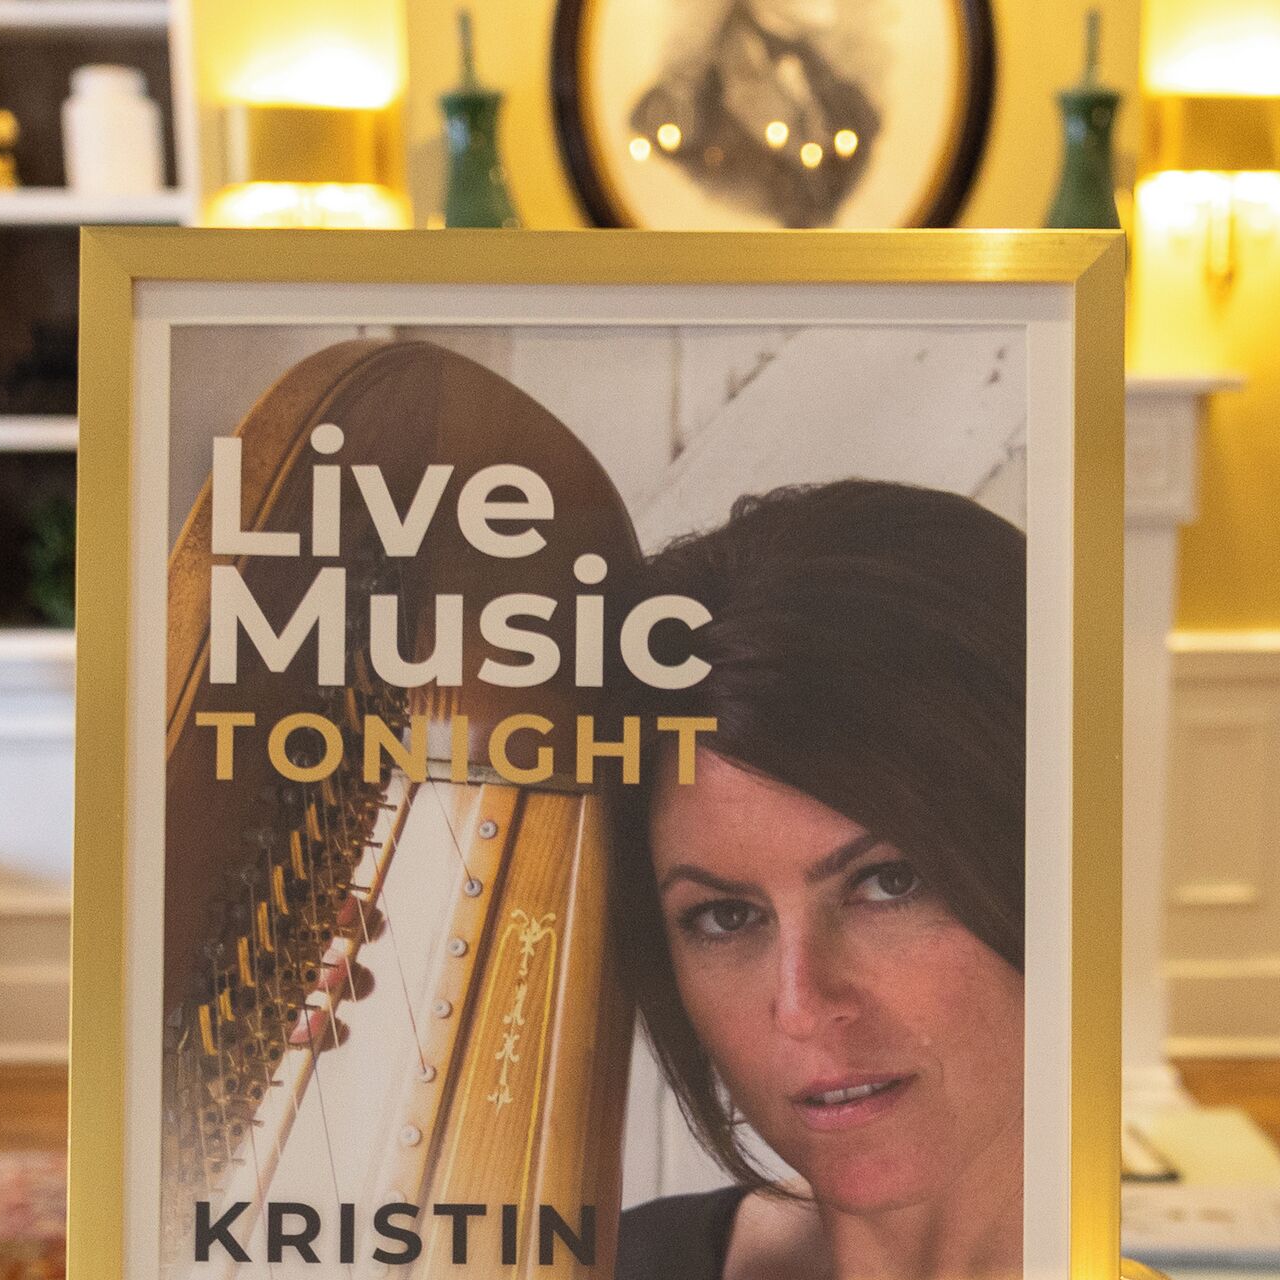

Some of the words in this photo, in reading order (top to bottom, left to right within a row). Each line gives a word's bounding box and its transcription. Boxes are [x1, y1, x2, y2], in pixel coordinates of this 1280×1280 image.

[210, 422, 555, 559] Live
[208, 554, 714, 691] Music
[195, 711, 718, 785] TONIGHT
[192, 1200, 598, 1267] KRISTIN
